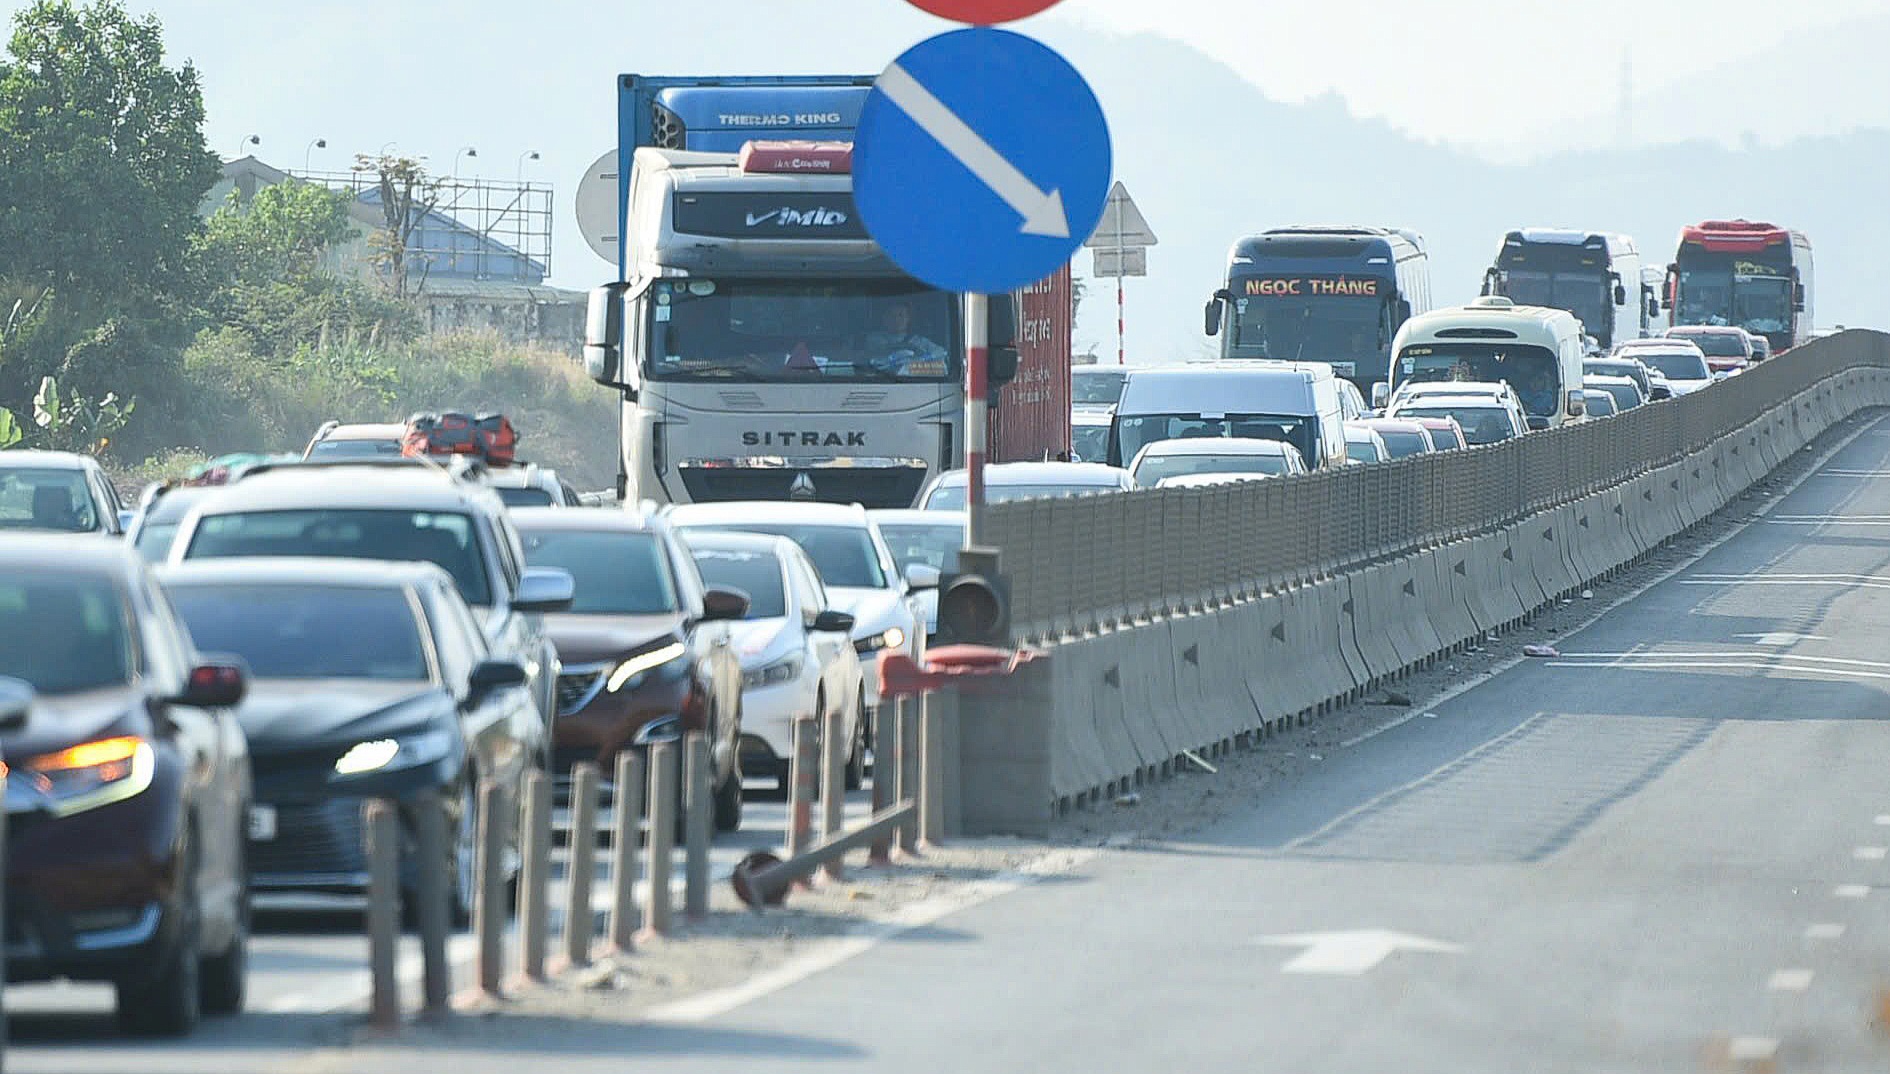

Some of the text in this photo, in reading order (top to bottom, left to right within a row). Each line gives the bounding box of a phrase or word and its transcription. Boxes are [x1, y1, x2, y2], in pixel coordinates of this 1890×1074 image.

[719, 113, 840, 126] THERMO KING
[1245, 279, 1300, 297] NGỌC
[742, 431, 865, 446] SITRAK
